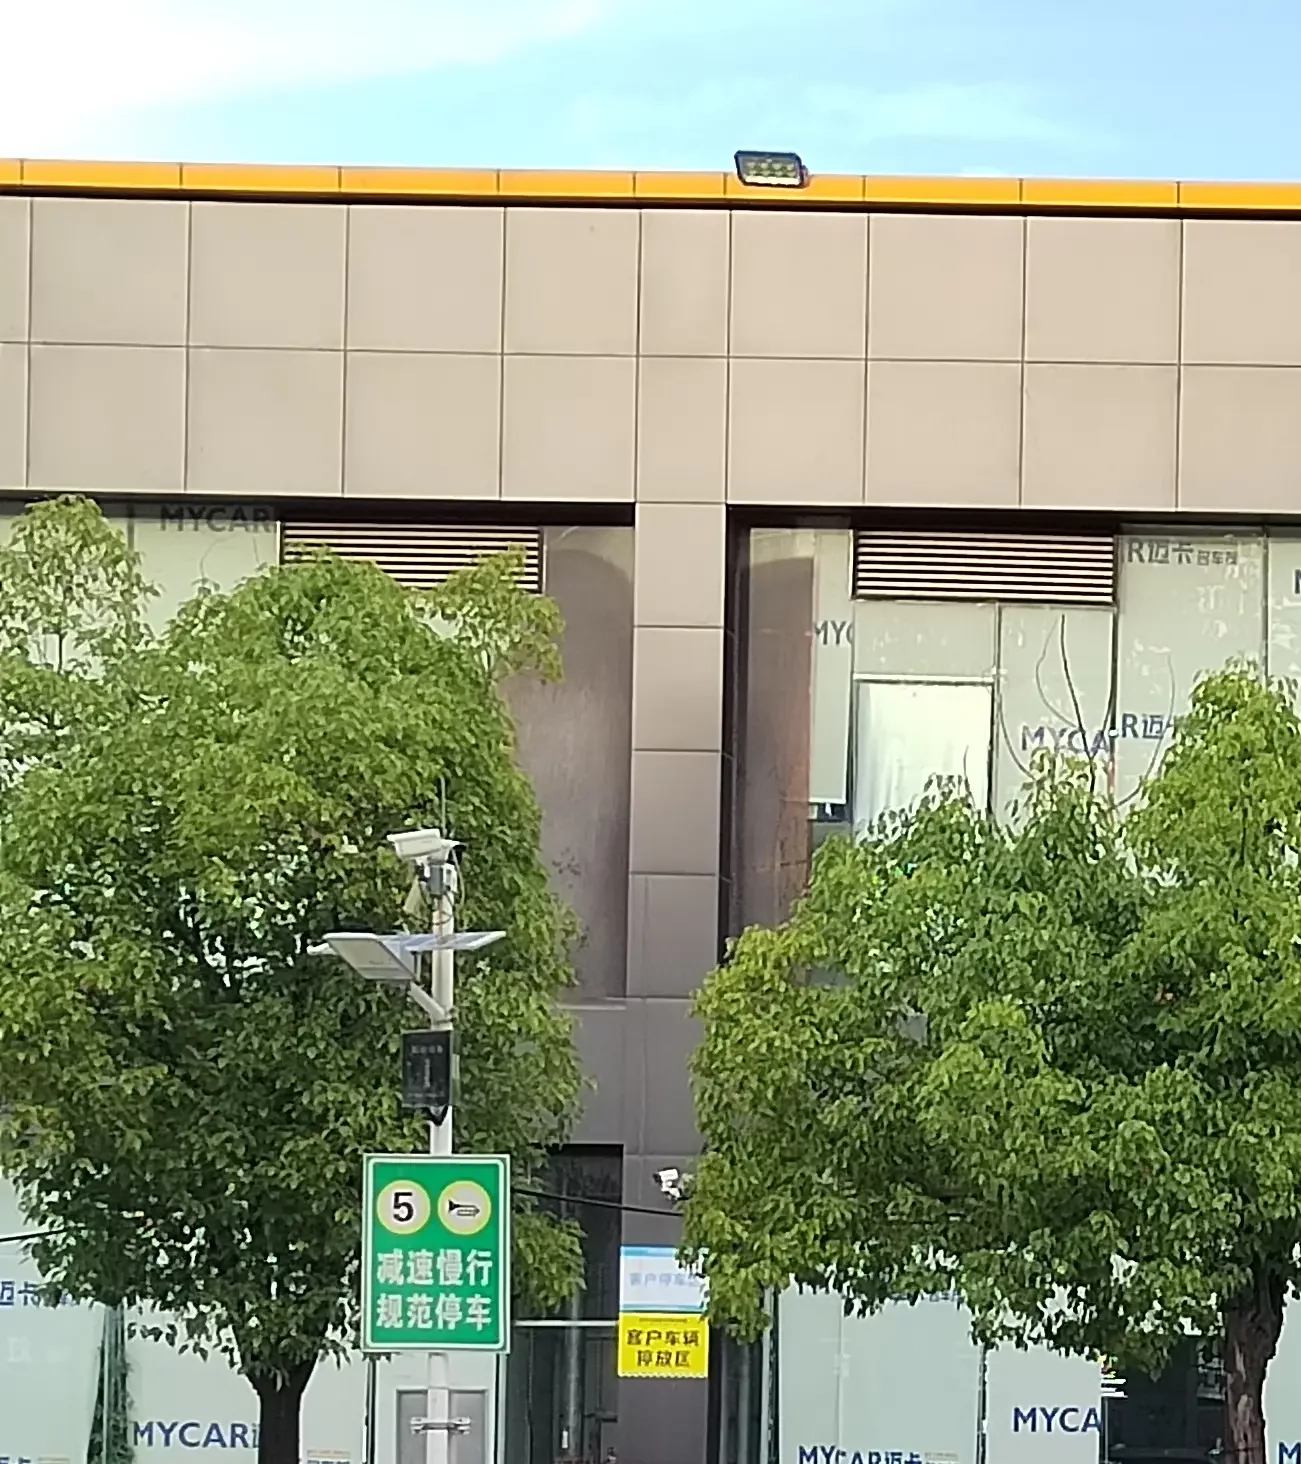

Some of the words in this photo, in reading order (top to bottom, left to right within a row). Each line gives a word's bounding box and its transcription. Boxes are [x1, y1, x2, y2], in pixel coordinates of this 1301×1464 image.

[160, 504, 271, 532] MYCAR
[393, 1192, 414, 1222] 5
[376, 1248, 493, 1286] 减速慢行
[376, 1293, 492, 1331] 规范停车
[133, 1421, 259, 1448] MYCAR
